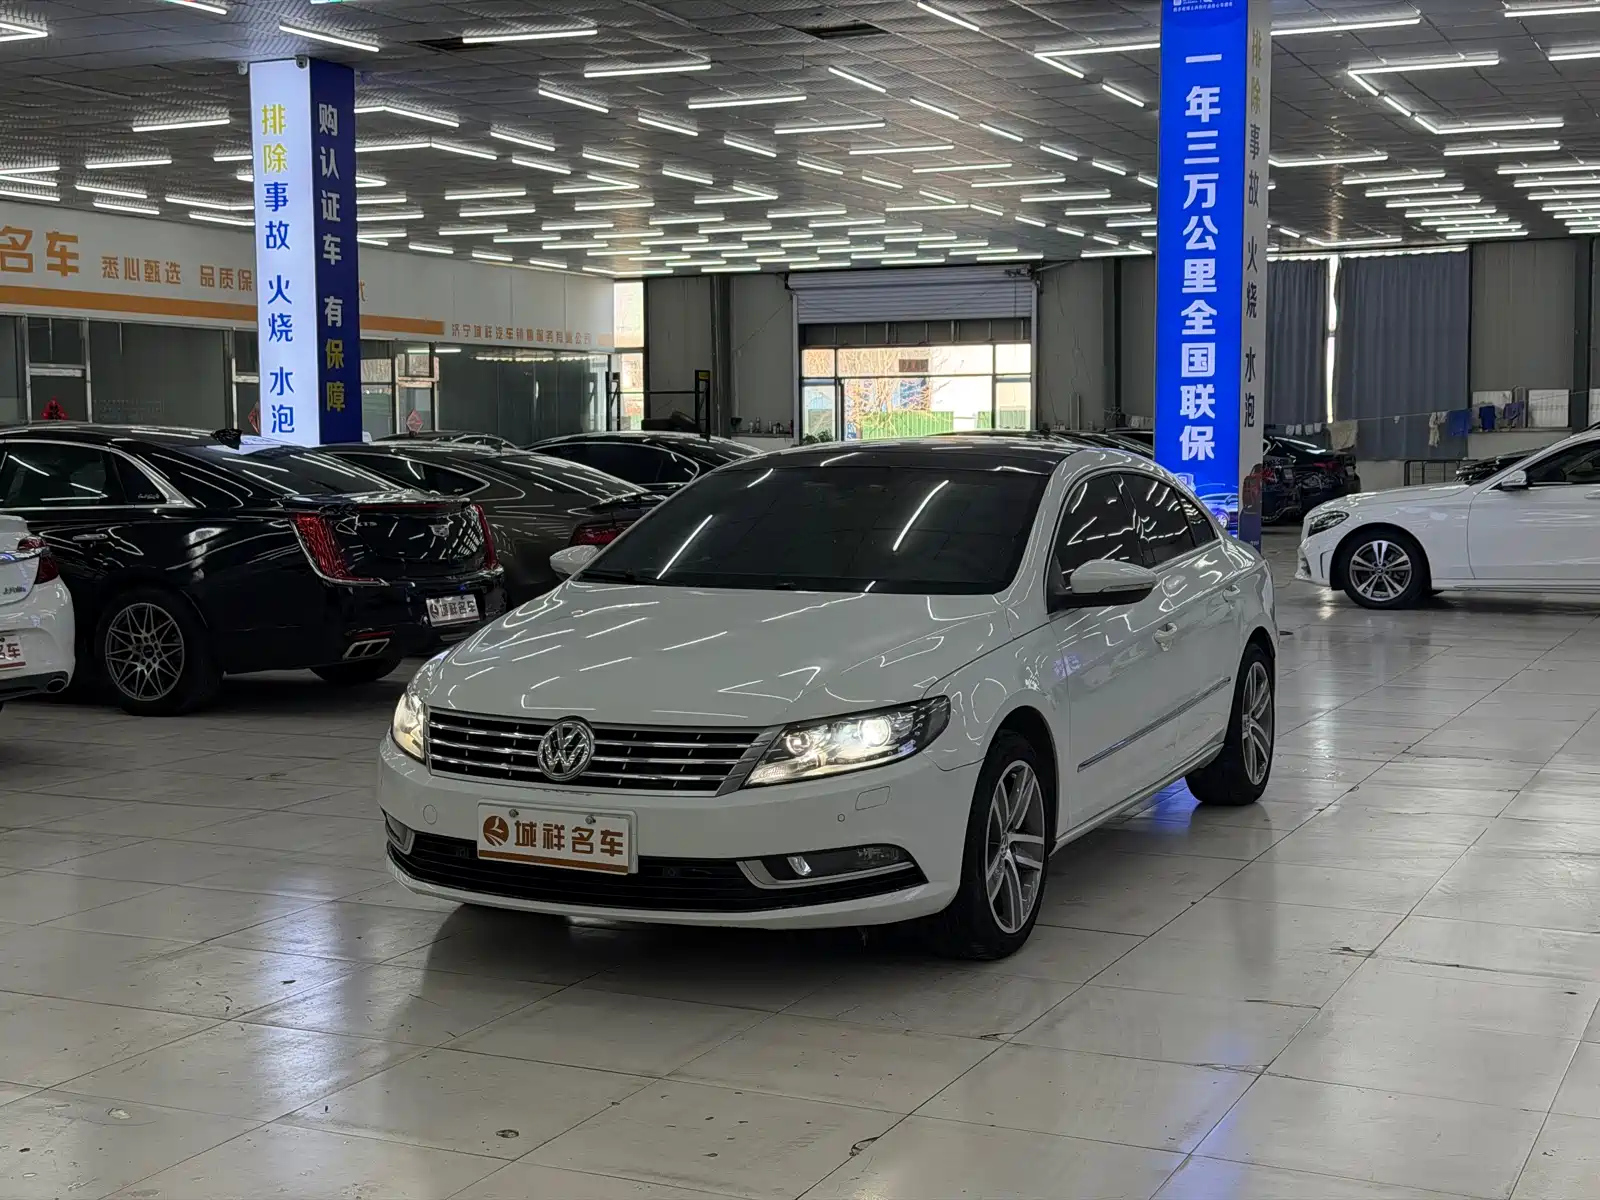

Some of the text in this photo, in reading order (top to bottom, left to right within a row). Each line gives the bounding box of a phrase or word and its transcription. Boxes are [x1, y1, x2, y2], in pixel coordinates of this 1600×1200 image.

[101, 256, 182, 285] 悉心甄选
[261, 104, 295, 433] 排除事故 火烧 水泡
[318, 103, 346, 412] 购认证车 有保障
[1179, 54, 1222, 461] 一年三万公里全国联保
[1243, 27, 1262, 428] 排除事故 火烧 水泡
[514, 820, 624, 857] 城祥名车
